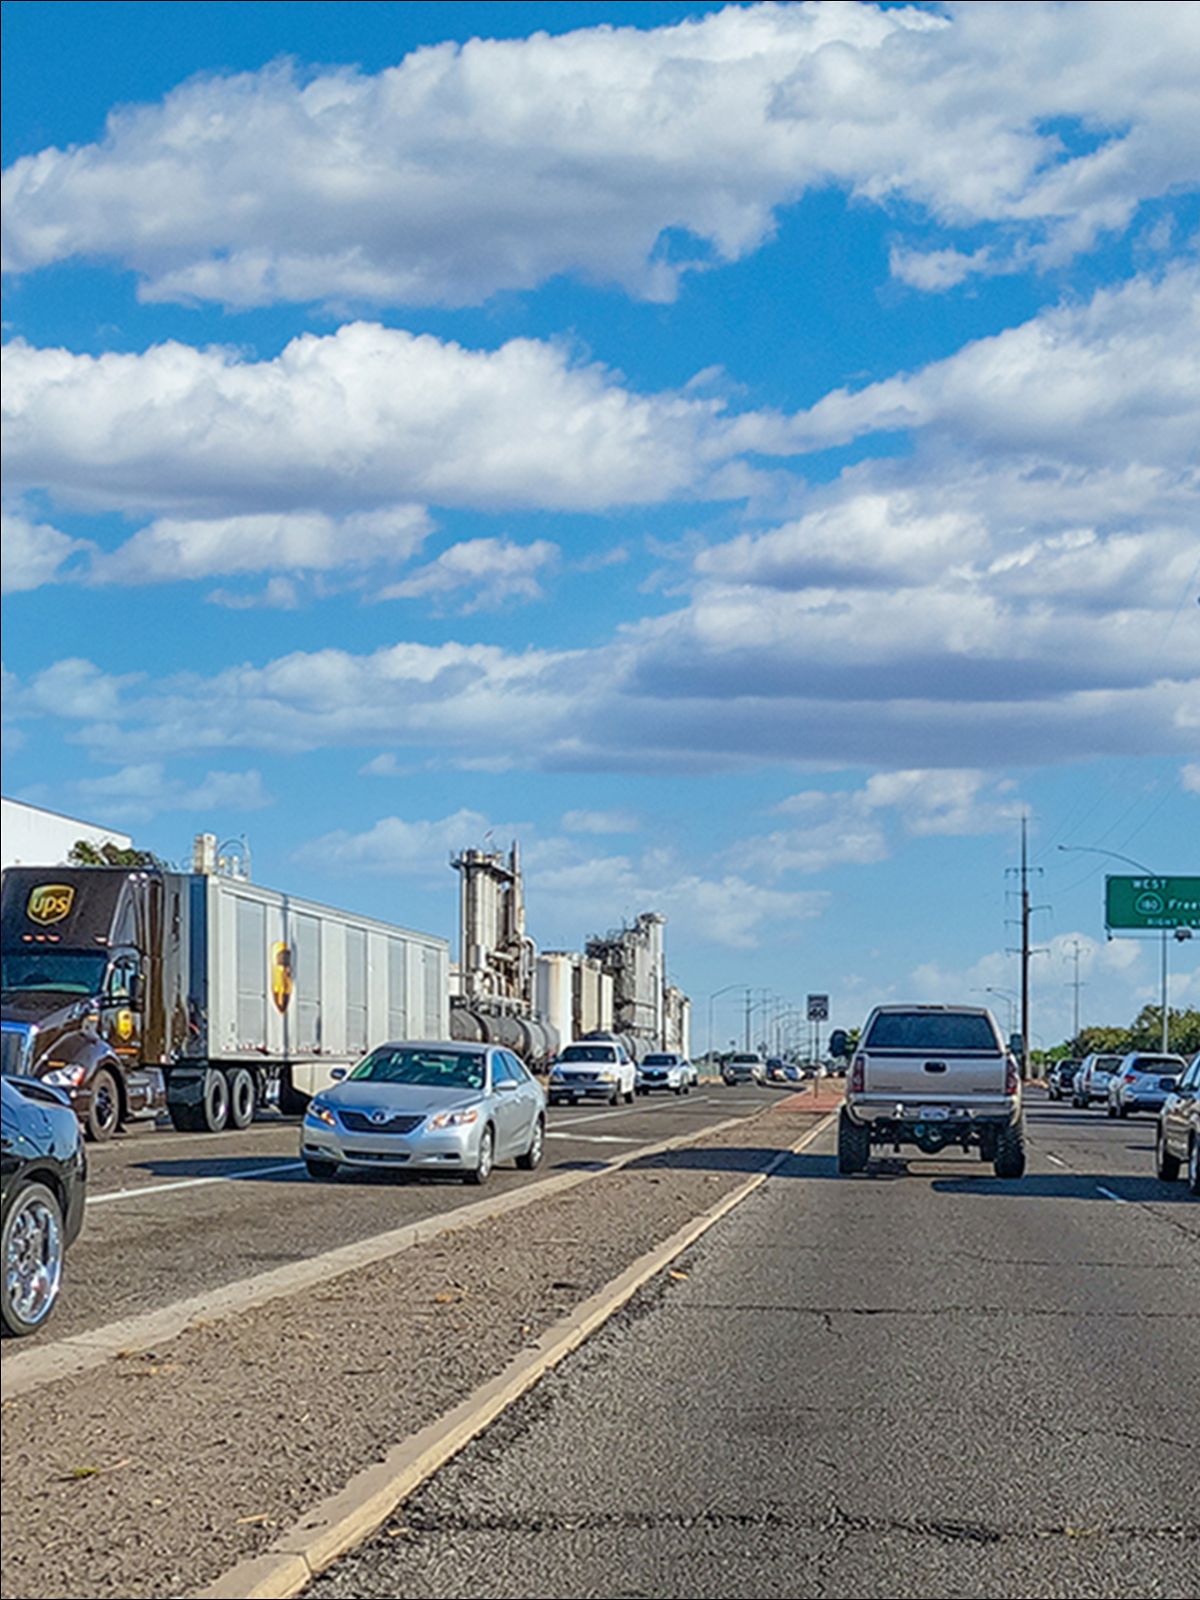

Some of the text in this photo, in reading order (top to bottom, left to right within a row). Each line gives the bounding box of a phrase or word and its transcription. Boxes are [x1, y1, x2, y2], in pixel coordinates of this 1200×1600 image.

[1132, 879, 1167, 890] WEST
[1147, 917, 1178, 926] RIGHT
[809, 1007, 828, 1020] 40
